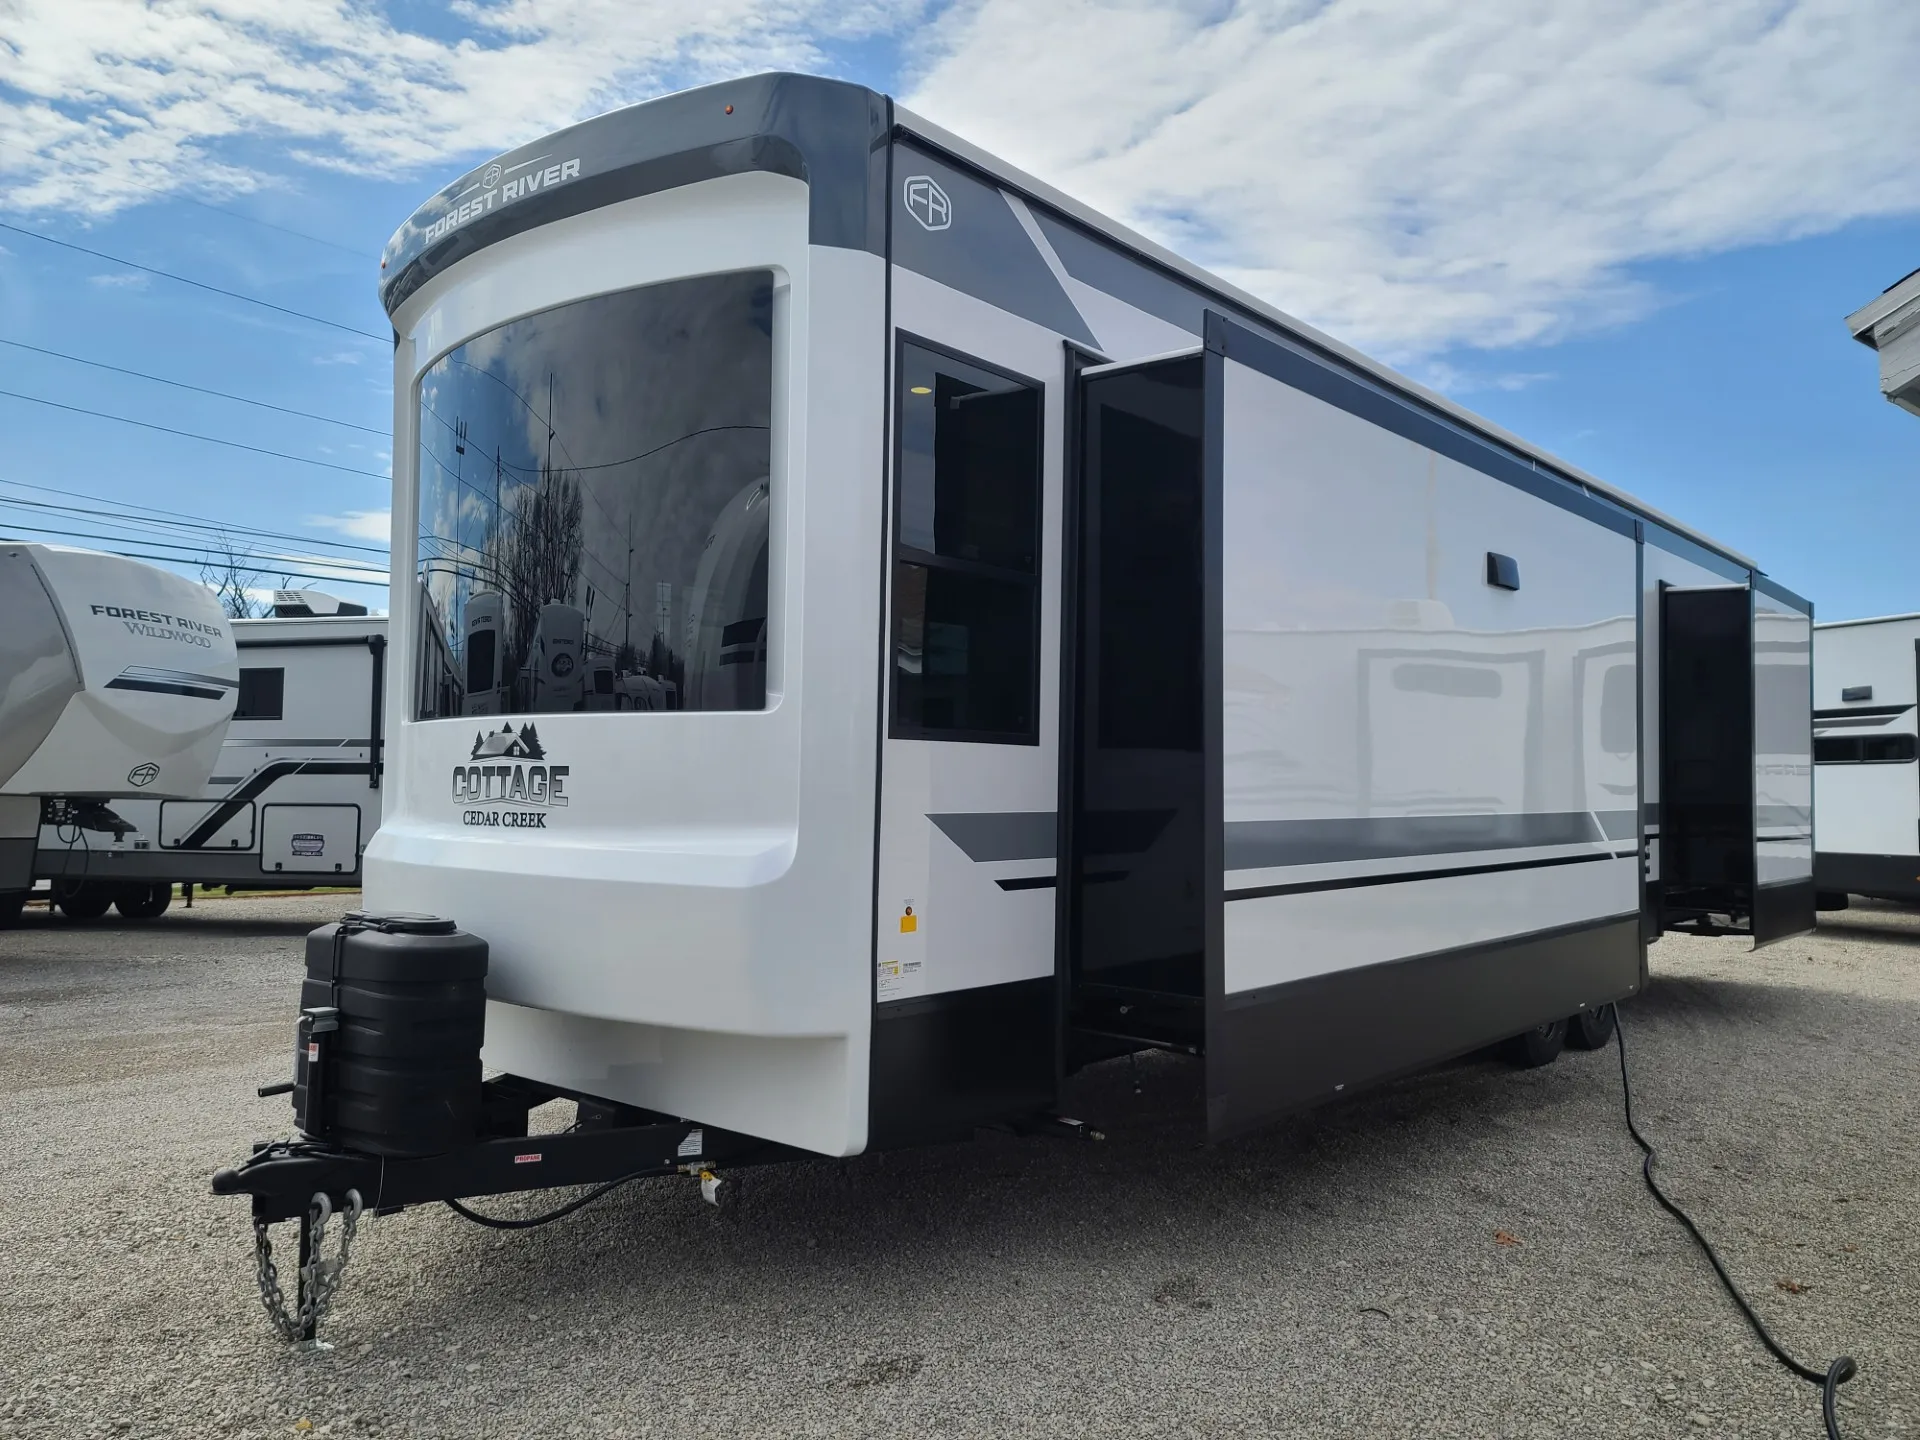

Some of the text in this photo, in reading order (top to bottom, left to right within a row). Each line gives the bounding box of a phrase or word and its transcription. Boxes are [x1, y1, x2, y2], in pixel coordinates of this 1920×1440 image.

[424, 158, 581, 244] FOREST RIVER
[90, 604, 223, 639] FOREST RIVER
[122, 621, 212, 649] WILDWOOD
[452, 765, 570, 807] COTTAGE
[463, 810, 547, 829] CEDAR CREEK
